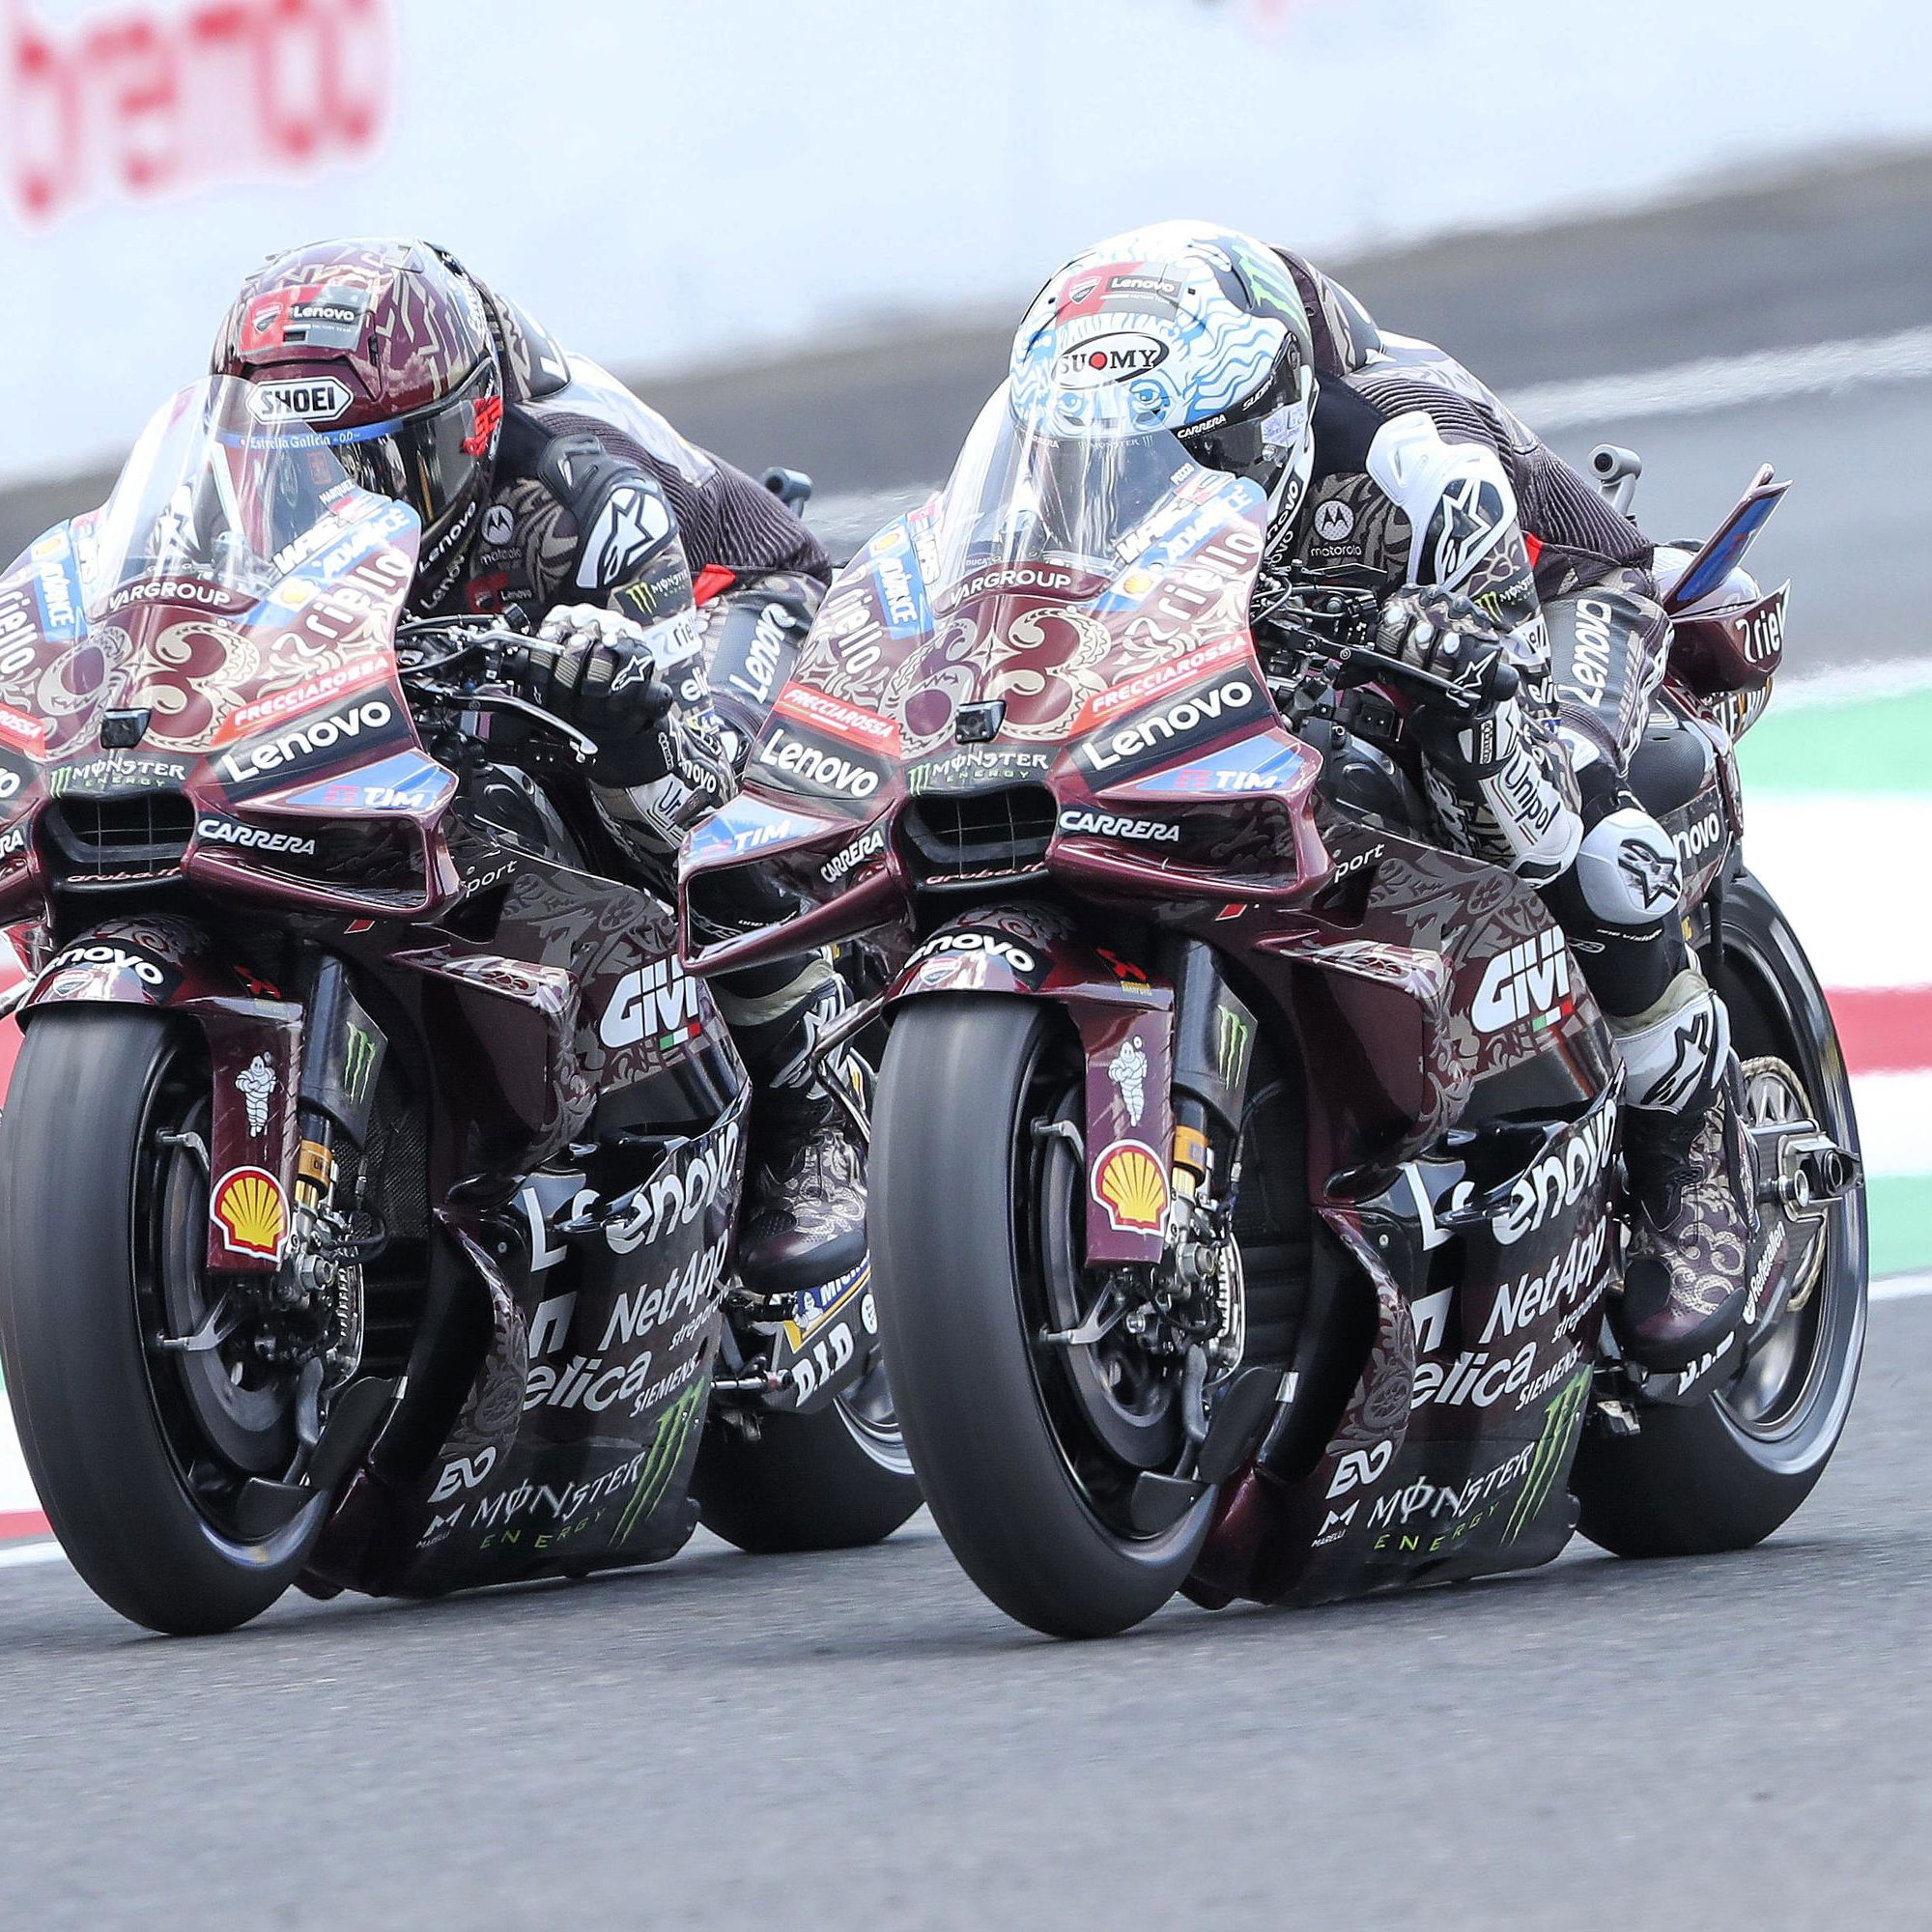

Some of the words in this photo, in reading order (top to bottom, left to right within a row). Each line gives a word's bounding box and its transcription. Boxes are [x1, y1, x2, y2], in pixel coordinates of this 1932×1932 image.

[1111, 277, 1175, 293] Lenovo
[293, 305, 355, 321] Lenovo
[1061, 350, 1157, 374] SUOMY
[261, 387, 335, 414] SHOEI
[1177, 413, 1227, 439] CARRERA
[419, 501, 476, 573] Lenovo
[1310, 544, 1362, 557] motorola
[109, 582, 232, 611] VARGROUP
[950, 569, 1071, 608] VARGROUP
[235, 656, 388, 725] FRECCIAROSSA
[1093, 635, 1246, 712] FRECCIAROSSA
[782, 689, 894, 739] FRECCIAROSSA
[1082, 681, 1253, 770] Lenovo
[222, 700, 392, 782] Lenovo
[760, 728, 879, 797] Lenovo
[932, 752, 1049, 777] MONSTER
[72, 757, 186, 781] MONSTER
[85, 778, 166, 788] ENERGY
[1216, 770, 1278, 789] TIM
[1505, 751, 1560, 836] Unipol
[364, 786, 425, 808] TIM
[198, 819, 316, 855] CARRERA
[734, 821, 791, 851] TIM
[1059, 810, 1180, 842] CARRERA
[821, 831, 884, 883] CARRERA
[600, 953, 699, 1048] GIVI
[1471, 923, 1571, 1034] GIVI
[598, 1229, 728, 1350] NetApp
[1478, 1214, 1606, 1344] NetApp
[523, 1350, 652, 1412] elica
[630, 1351, 702, 1417] SIEMENS
[1410, 1341, 1537, 1410] elica
[1516, 1343, 1582, 1412] SIEMENS
[470, 1451, 646, 1528] MONSTER
[1367, 1441, 1536, 1529] MONSTER
[480, 1507, 607, 1548] ENERGY
[1374, 1502, 1499, 1552] ENERGY
